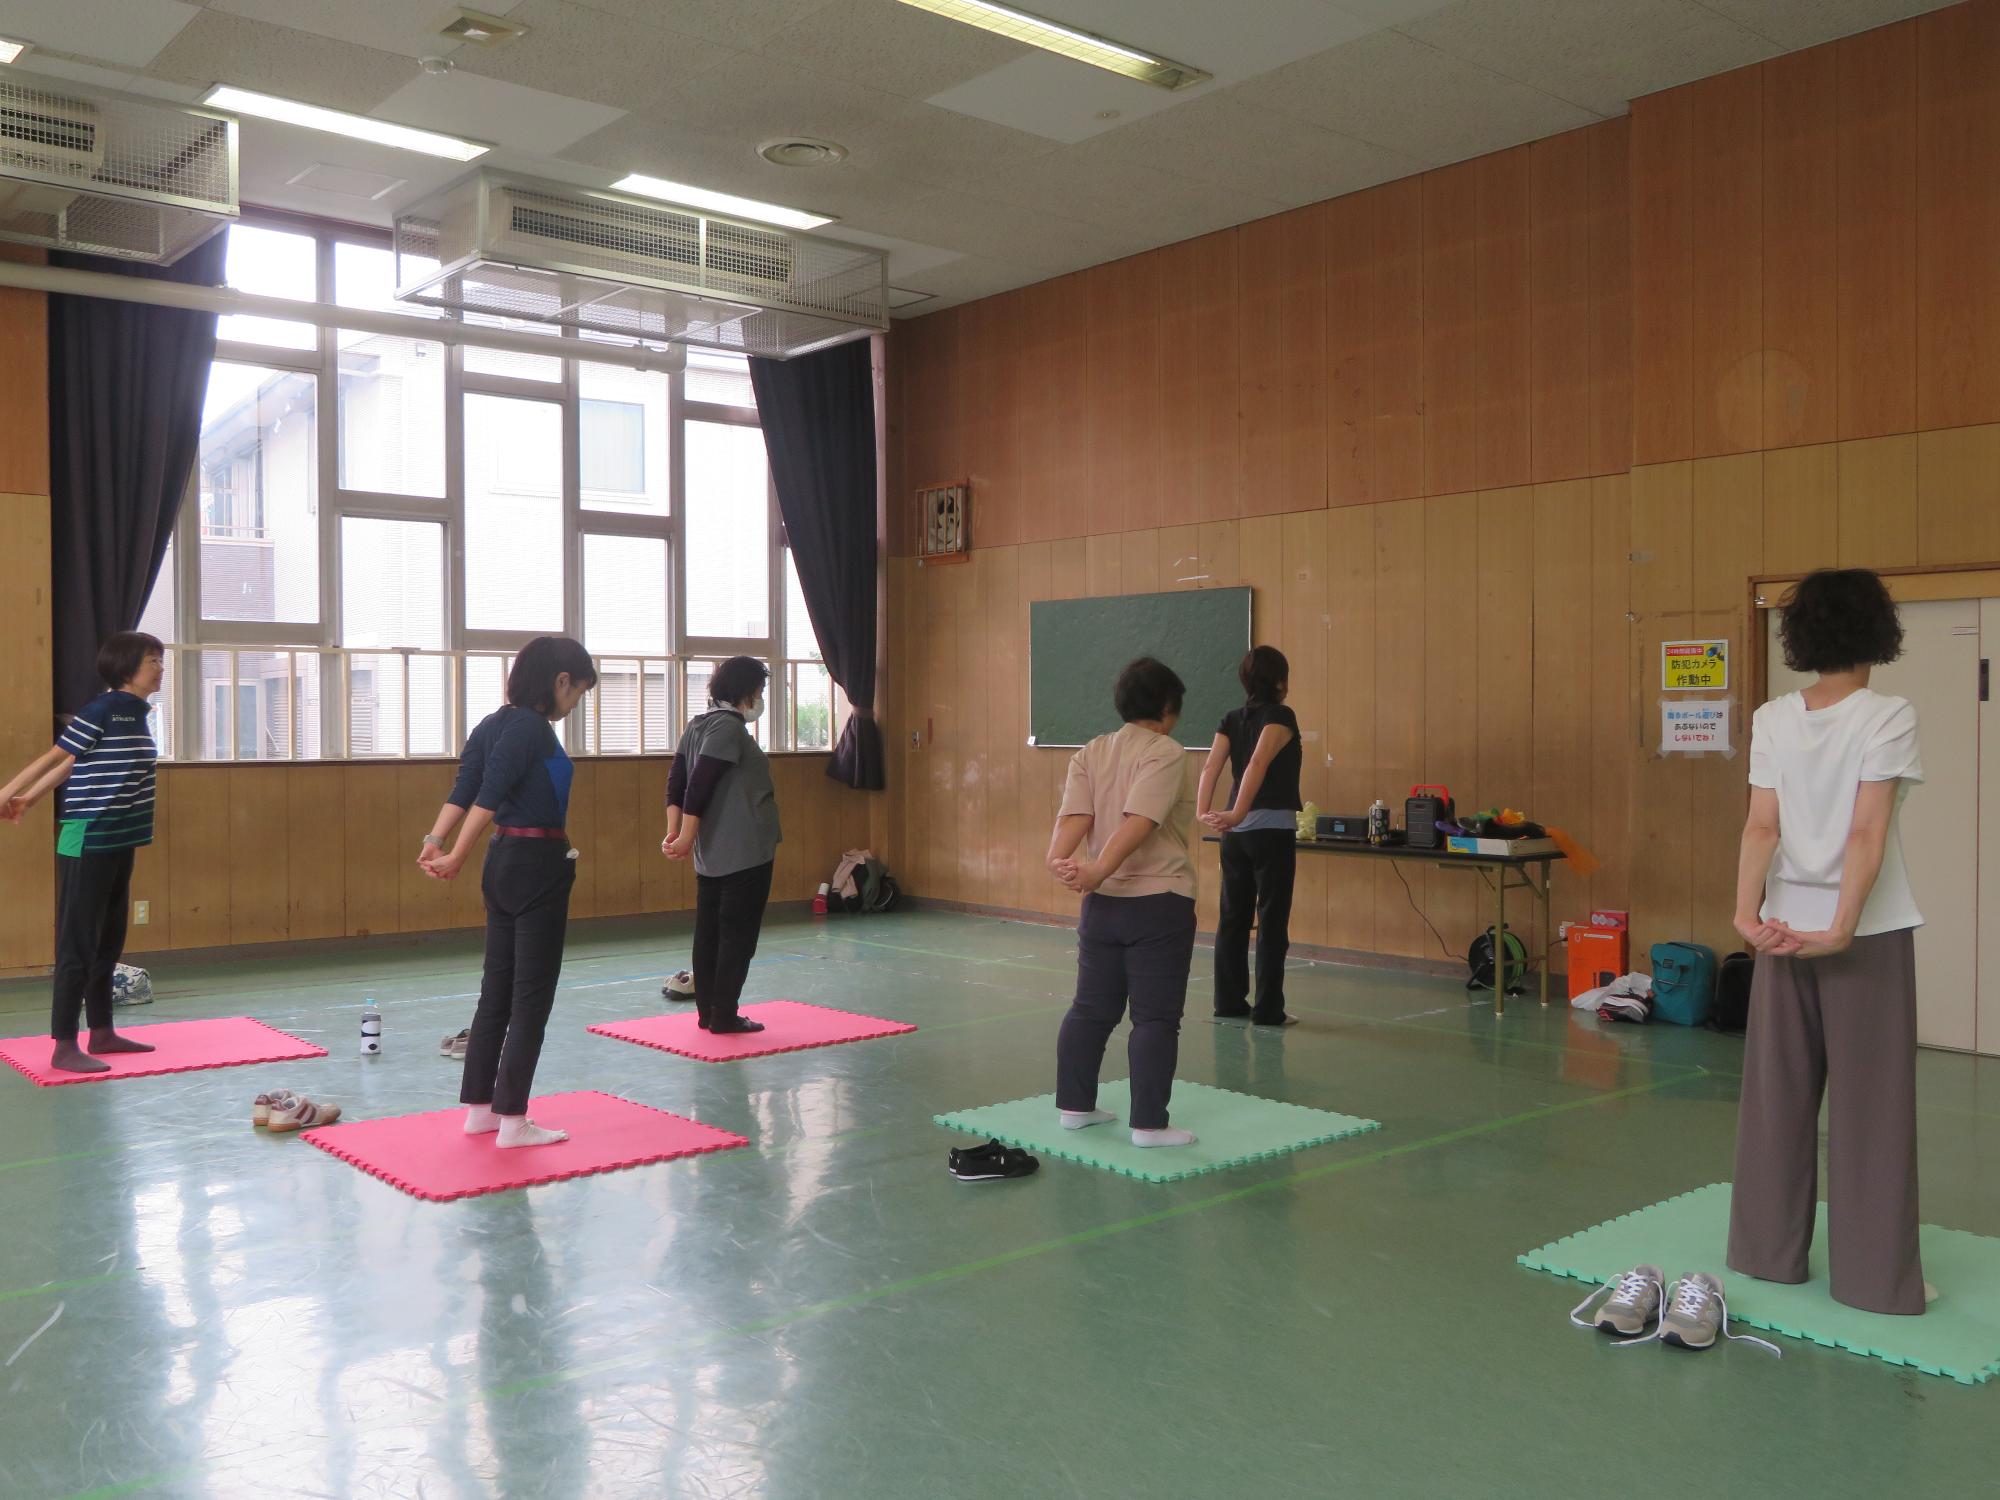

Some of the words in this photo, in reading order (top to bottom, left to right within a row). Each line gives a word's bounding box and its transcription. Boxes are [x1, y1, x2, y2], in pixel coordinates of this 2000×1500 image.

[1671, 658, 1716, 669] 防犯カメラ
[1677, 674, 1711, 685] 作動中
[1674, 722, 1716, 730] あぶないので
